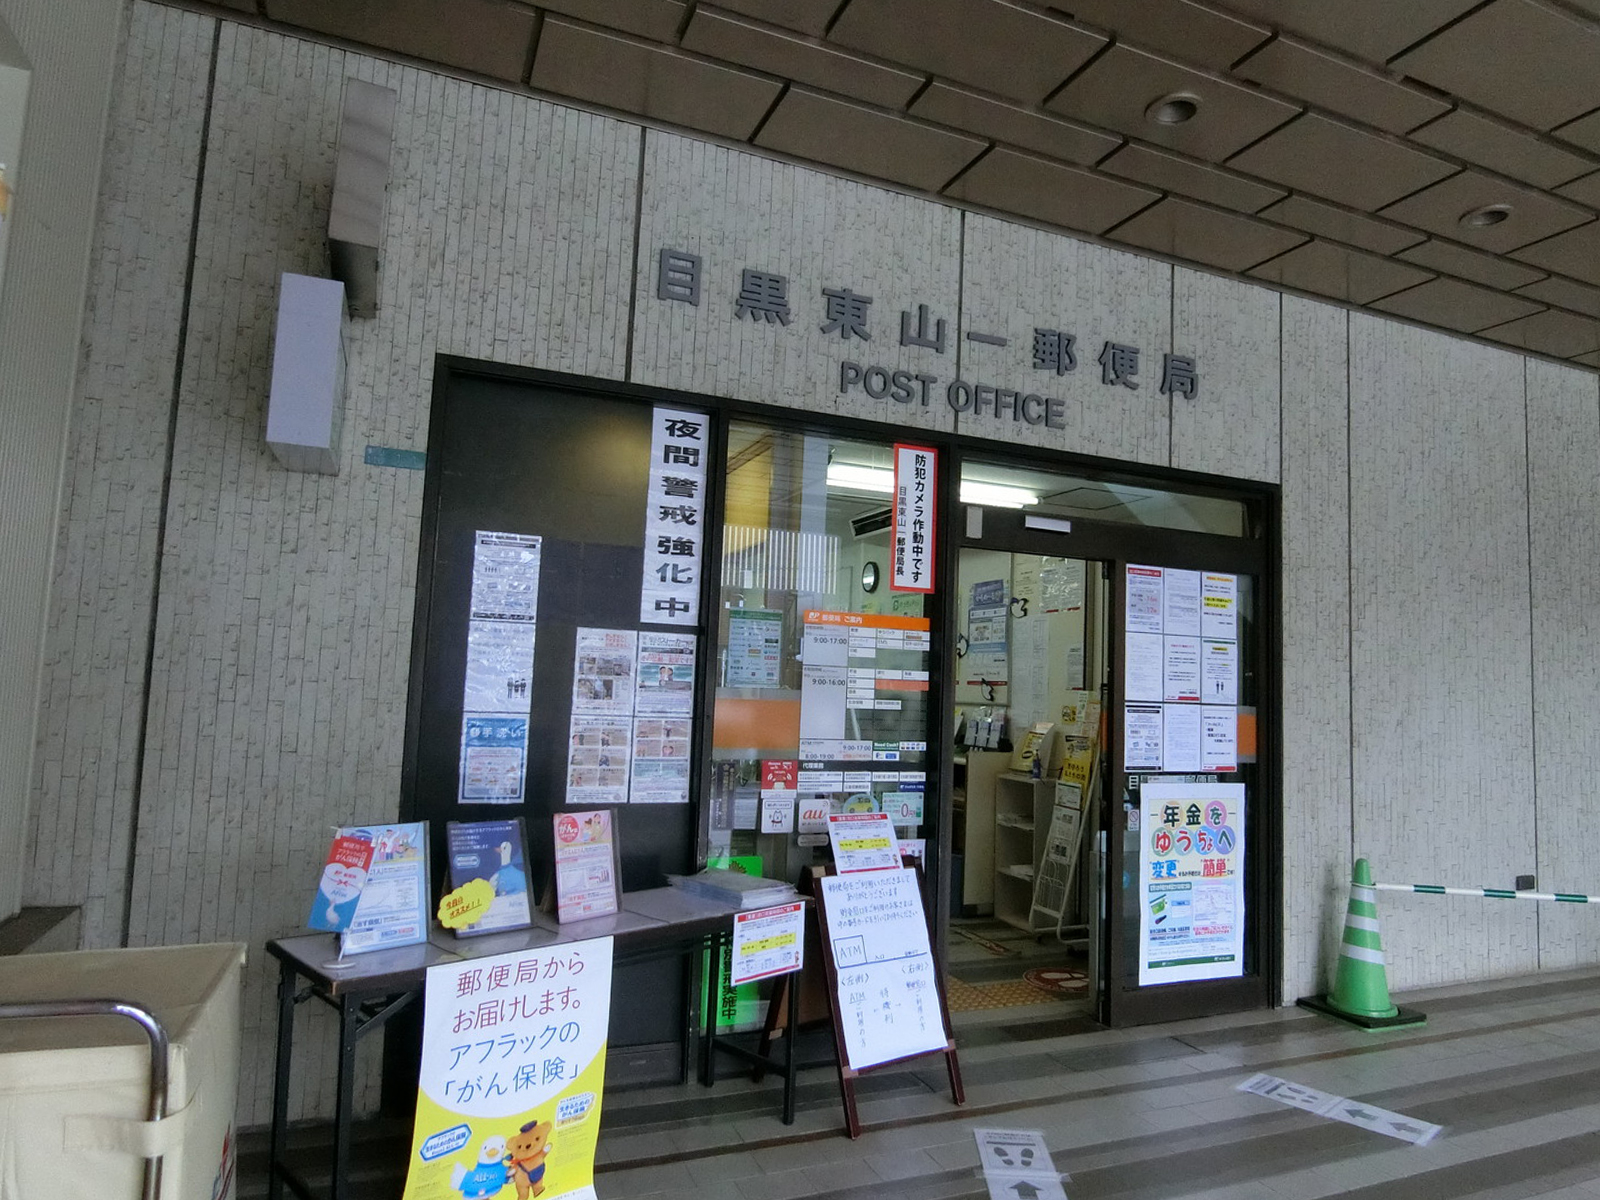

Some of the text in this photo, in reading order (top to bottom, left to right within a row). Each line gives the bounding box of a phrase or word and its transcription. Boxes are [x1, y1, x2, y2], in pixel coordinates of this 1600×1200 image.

[657, 248, 1200, 400] 目黒東山一郵便局
[841, 362, 1066, 429] POST OFFICE
[655, 418, 702, 617] 夜間警戒強化中
[911, 454, 927, 583] 防犯カメラ作動中です
[896, 486, 907, 577] 目黒東山一郵便局長
[844, 615, 862, 624] ご案内
[814, 636, 847, 645] 9:00-17:00
[812, 678, 846, 687] 9:00-16:00
[803, 810, 826, 820] au
[1163, 803, 1222, 828] 年金を
[1155, 830, 1232, 854] ゆうちょへ
[1151, 859, 1178, 878] 変更
[1202, 859, 1228, 877] 簡単
[847, 887, 898, 901] ありがとうございます
[840, 944, 862, 958] ATM
[456, 952, 585, 999] 郵便局から
[850, 991, 866, 1001] ATM
[452, 986, 581, 1034] お届けします。
[449, 1021, 581, 1071] アフラックの
[444, 1057, 580, 1104] 「がん保険」
[559, 1097, 591, 1113] 生きるための
[561, 1106, 586, 1119] がん保険
